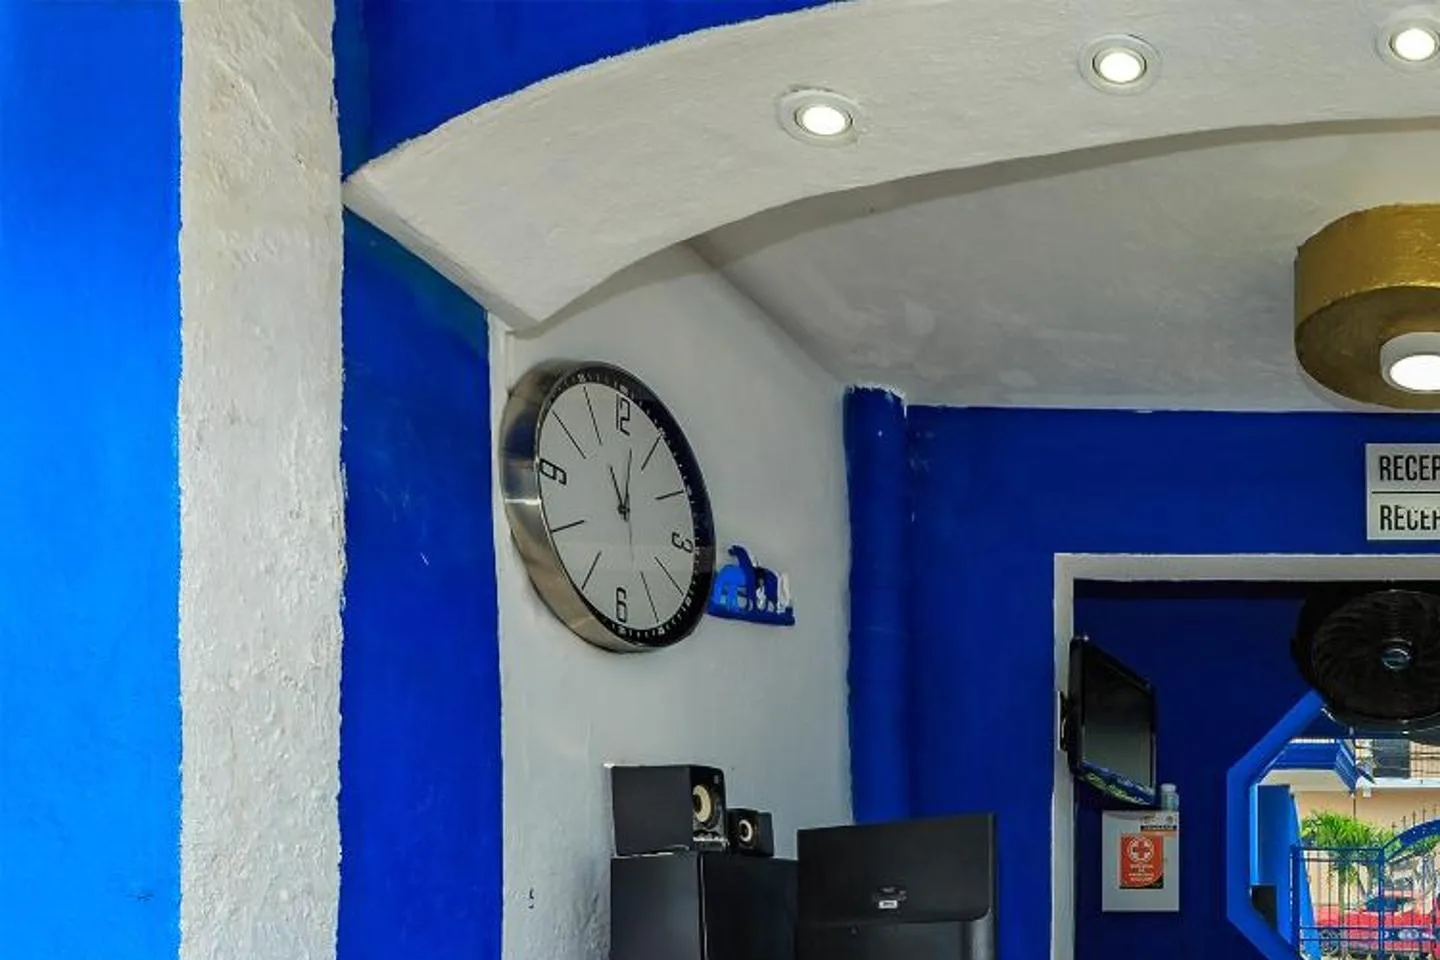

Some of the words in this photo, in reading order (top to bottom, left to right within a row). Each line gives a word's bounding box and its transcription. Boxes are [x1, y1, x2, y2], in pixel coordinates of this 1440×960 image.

[616, 394, 631, 436] 12
[671, 531, 694, 554] 3
[615, 586, 628, 623] 6
